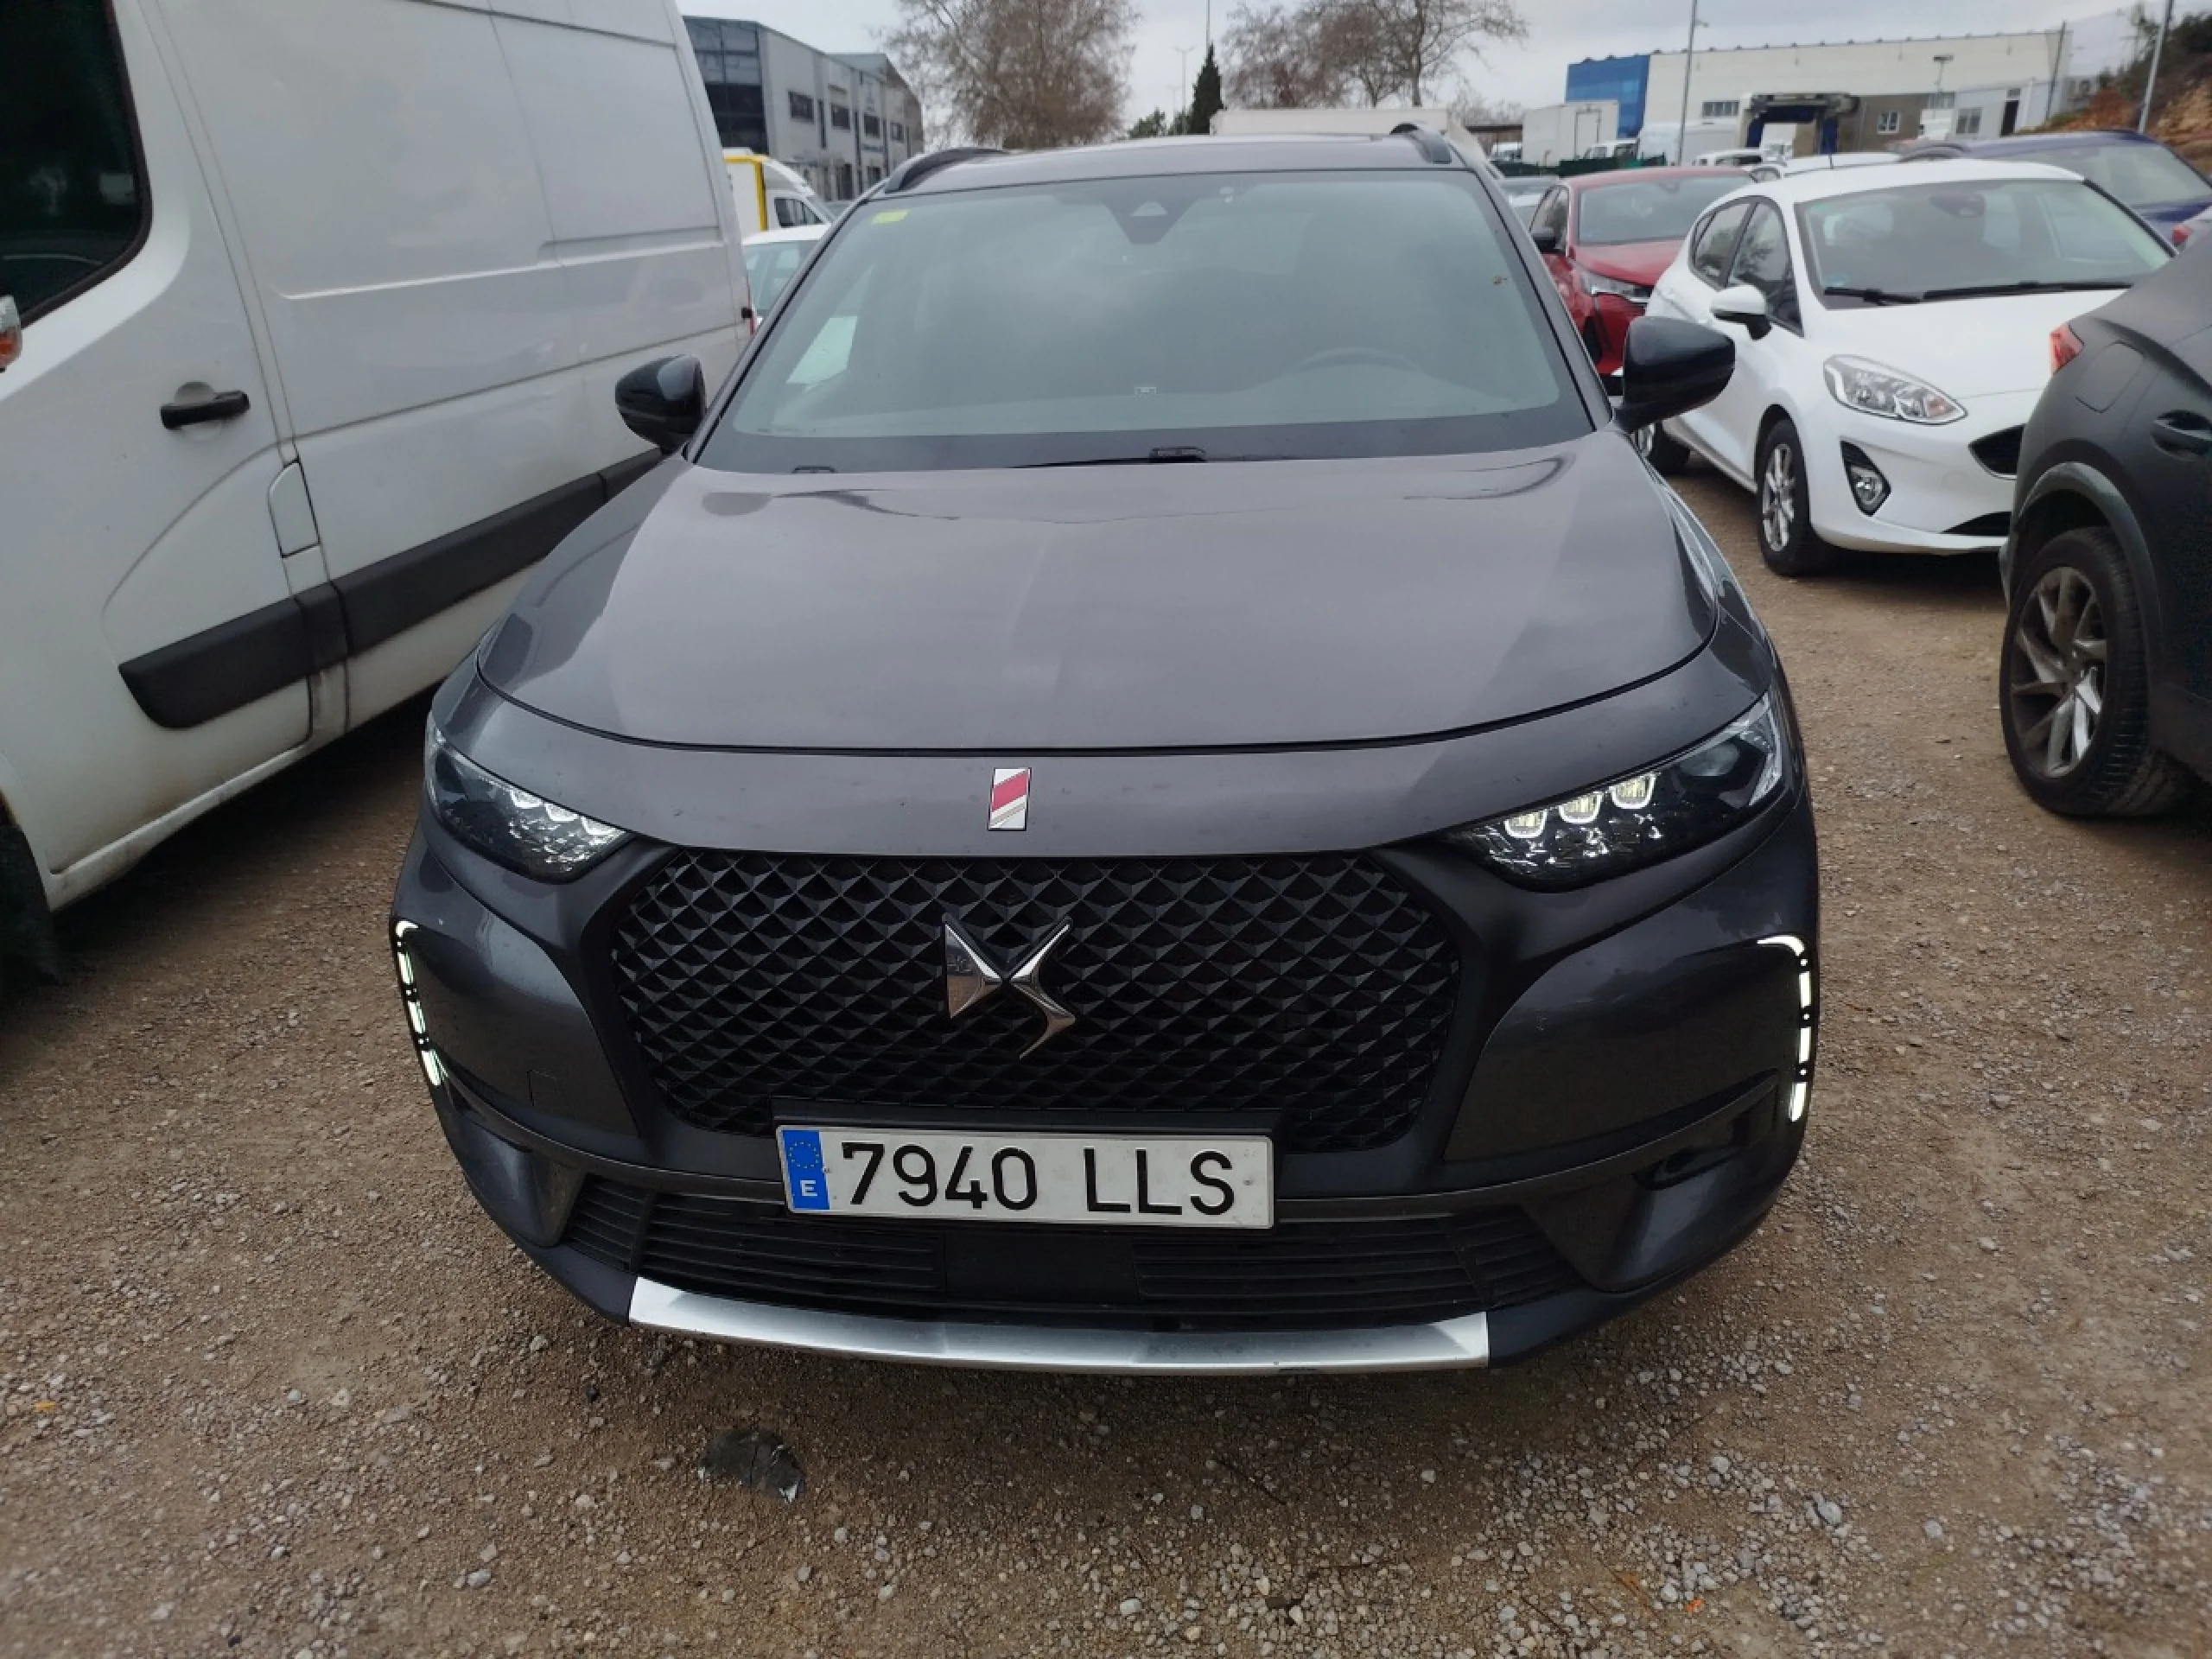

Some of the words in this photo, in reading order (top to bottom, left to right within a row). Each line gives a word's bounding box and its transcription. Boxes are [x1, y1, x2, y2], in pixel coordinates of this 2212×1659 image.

[799, 1179, 818, 1197] E
[842, 1141, 1038, 1211] 7940
[1083, 1147, 1235, 1216] LLS
